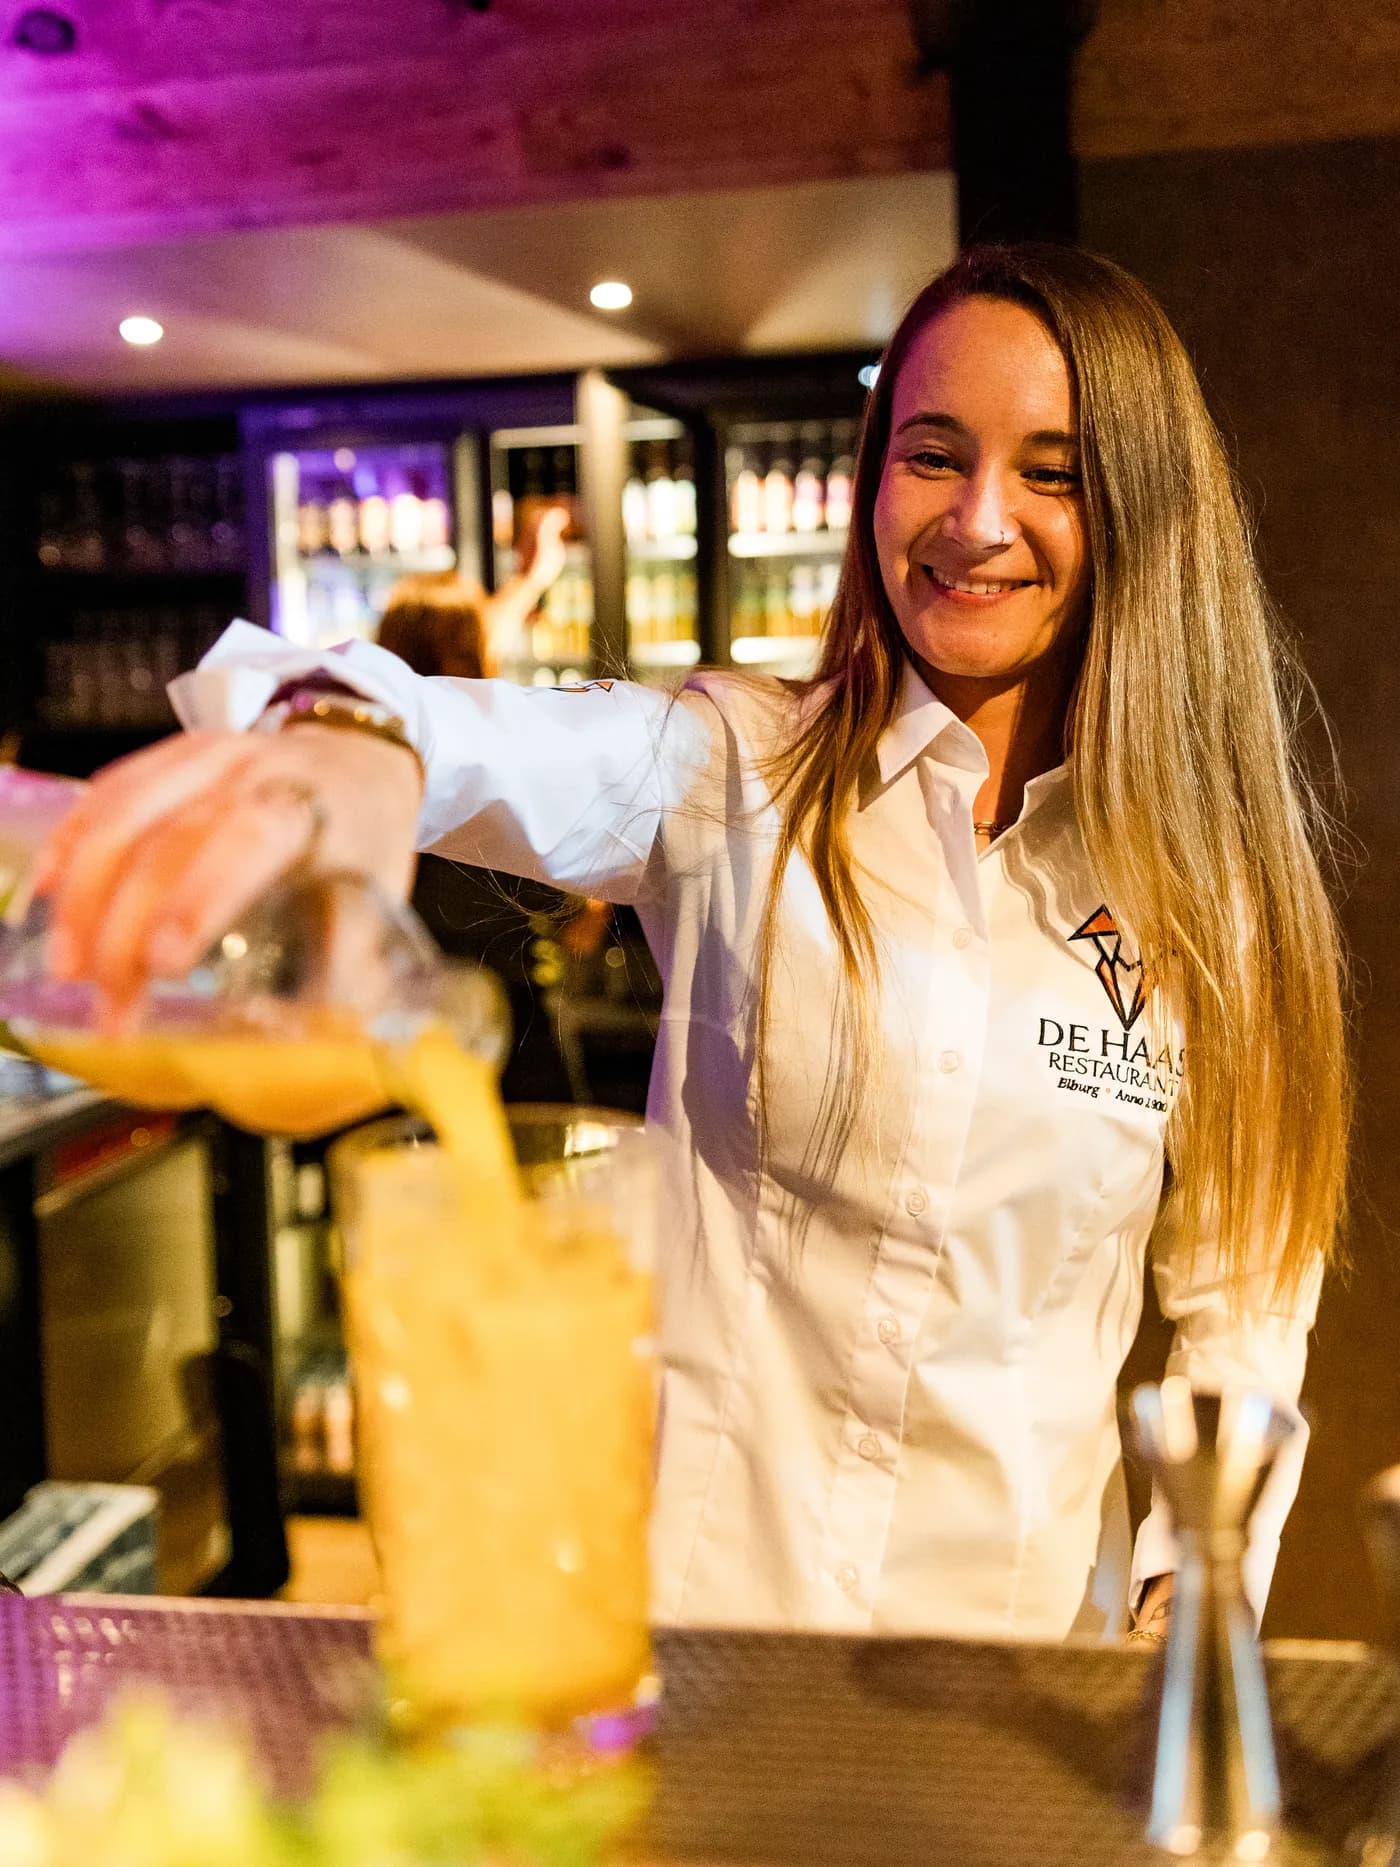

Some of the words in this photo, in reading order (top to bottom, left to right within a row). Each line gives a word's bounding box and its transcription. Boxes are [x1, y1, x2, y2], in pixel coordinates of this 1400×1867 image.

[1038, 1018, 1090, 1053] DE
[1049, 1052, 1179, 1097] RESTAURANT
[1115, 1089, 1144, 1106] Anno
